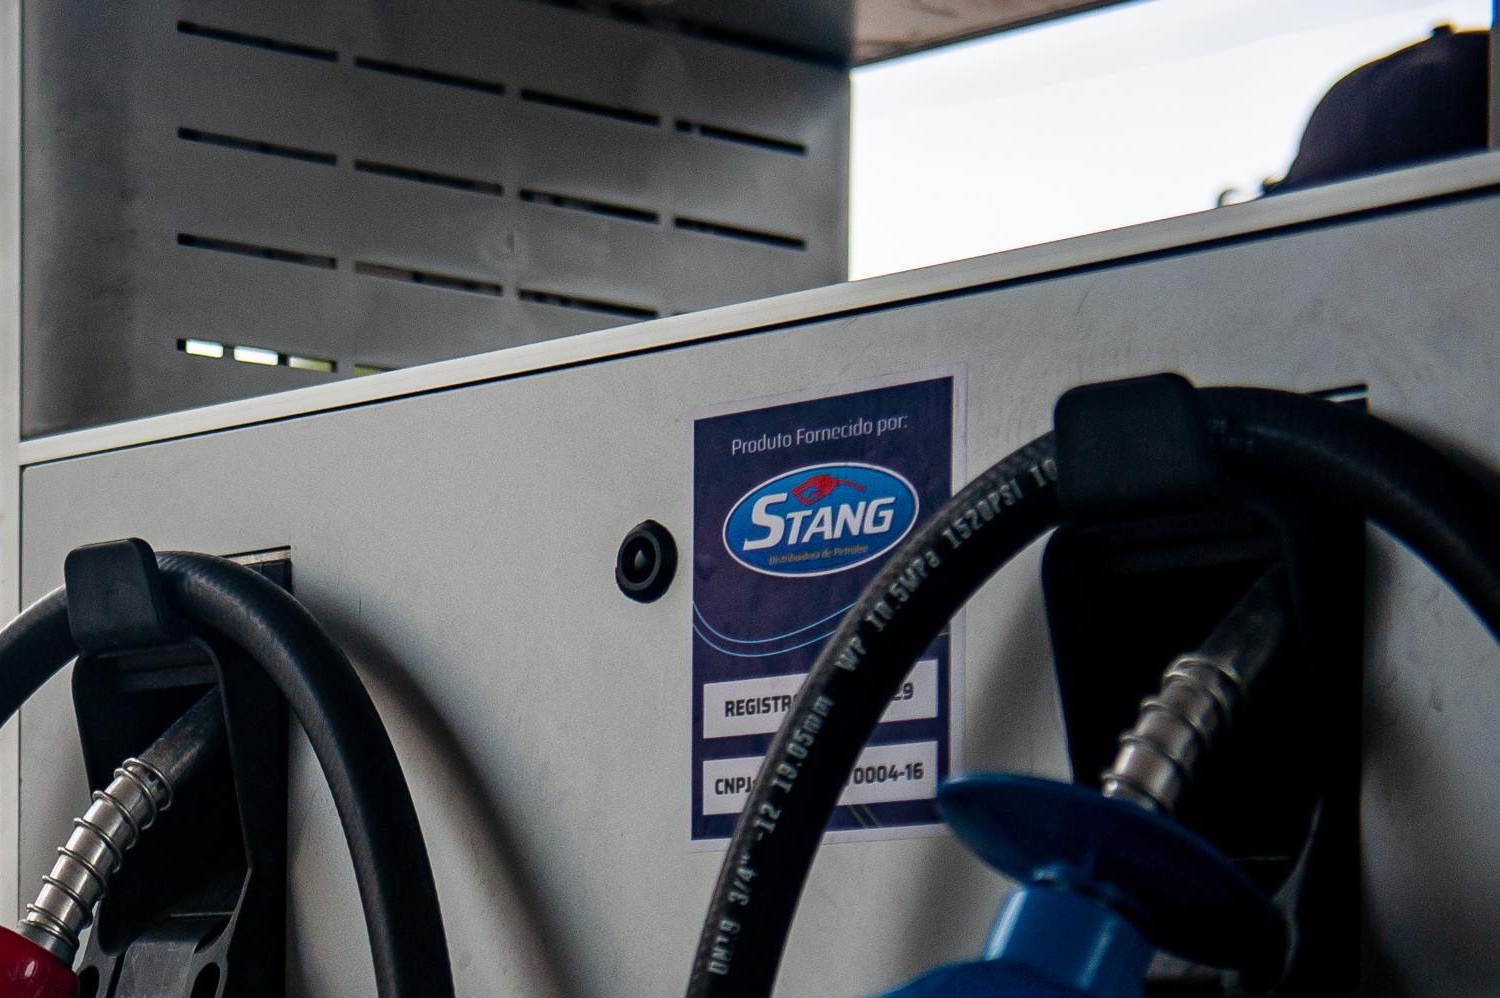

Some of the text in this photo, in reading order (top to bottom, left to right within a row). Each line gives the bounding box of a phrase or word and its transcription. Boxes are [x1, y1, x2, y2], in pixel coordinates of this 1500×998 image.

[731, 414, 908, 456] Produto Fornecido por:
[743, 492, 896, 551] STANG
[725, 694, 797, 717] REGISTR
